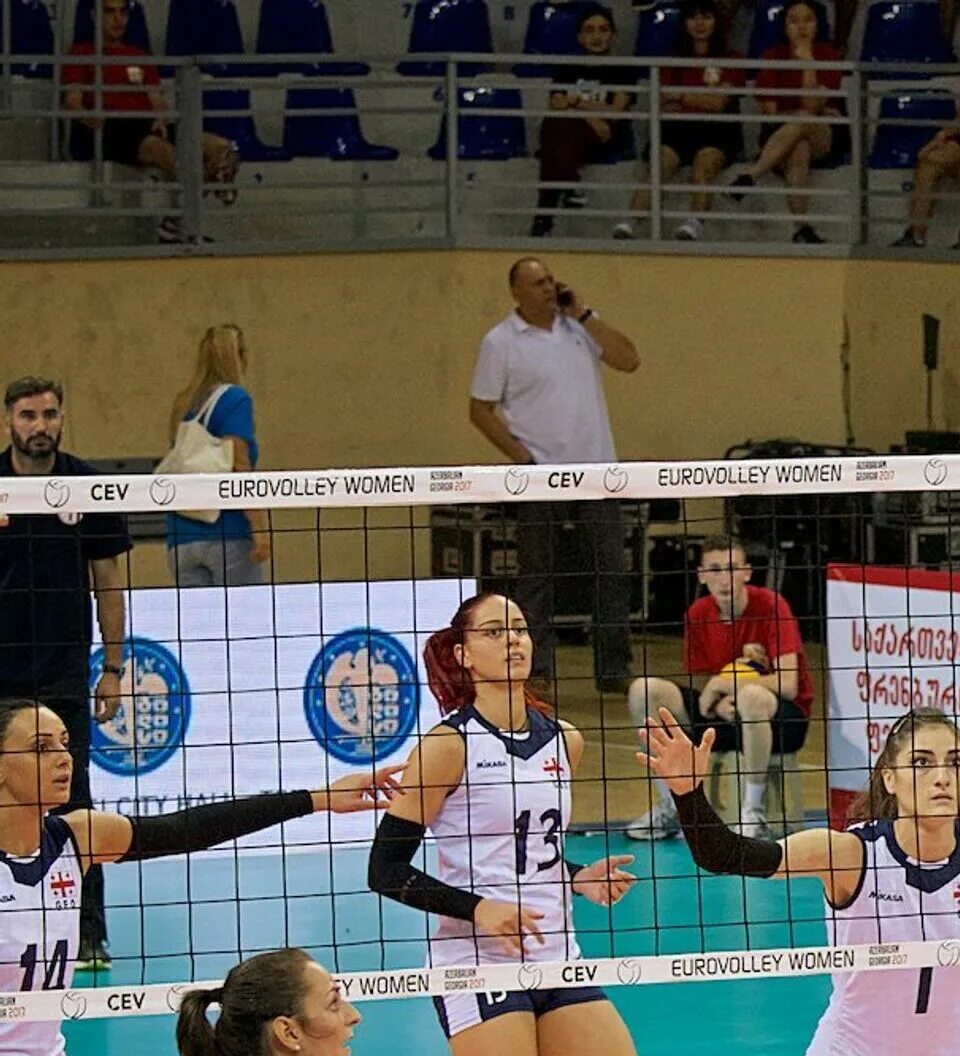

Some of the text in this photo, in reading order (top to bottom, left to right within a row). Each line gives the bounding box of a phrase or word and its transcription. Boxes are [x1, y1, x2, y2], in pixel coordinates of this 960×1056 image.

[547, 472, 585, 489] CEV
[658, 464, 842, 486] EUROVOLLEY WOMEN
[91, 483, 128, 501] CEV
[218, 475, 415, 500] EUROVOLLEY WOMEN
[516, 808, 562, 875] 13
[21, 939, 69, 991] 14
[562, 965, 598, 983] CEV
[671, 950, 855, 977] EUROVOLLEY WOMEN
[360, 974, 430, 995] WOMEN
[108, 993, 146, 1012] CEV
